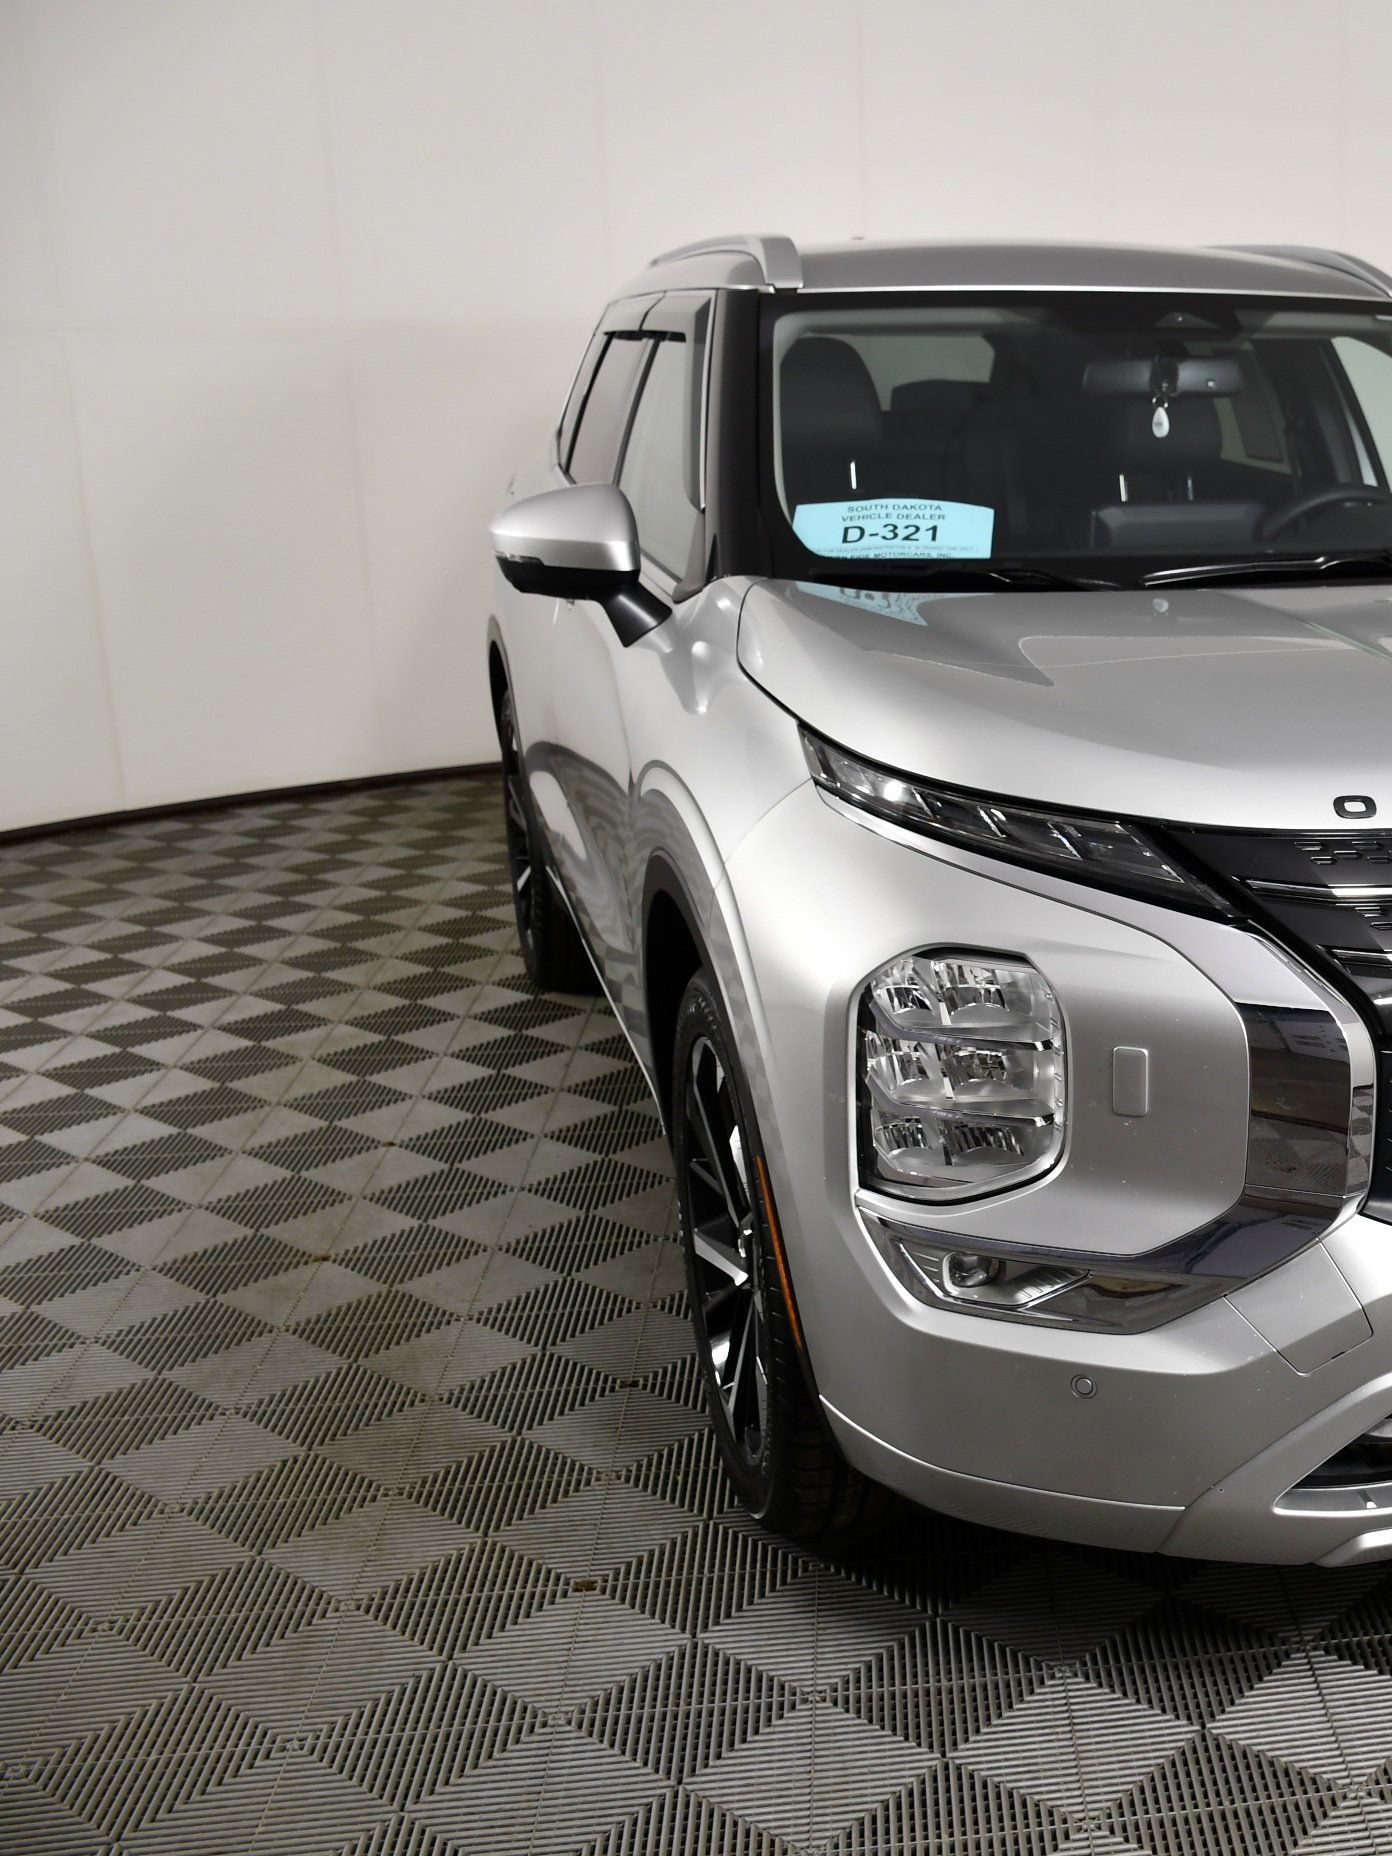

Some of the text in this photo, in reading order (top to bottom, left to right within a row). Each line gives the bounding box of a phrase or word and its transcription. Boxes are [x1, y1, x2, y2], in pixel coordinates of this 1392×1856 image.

[847, 504, 889, 512] SOUTH
[841, 513, 893, 522] VEHICLE
[842, 523, 938, 543] D-321
